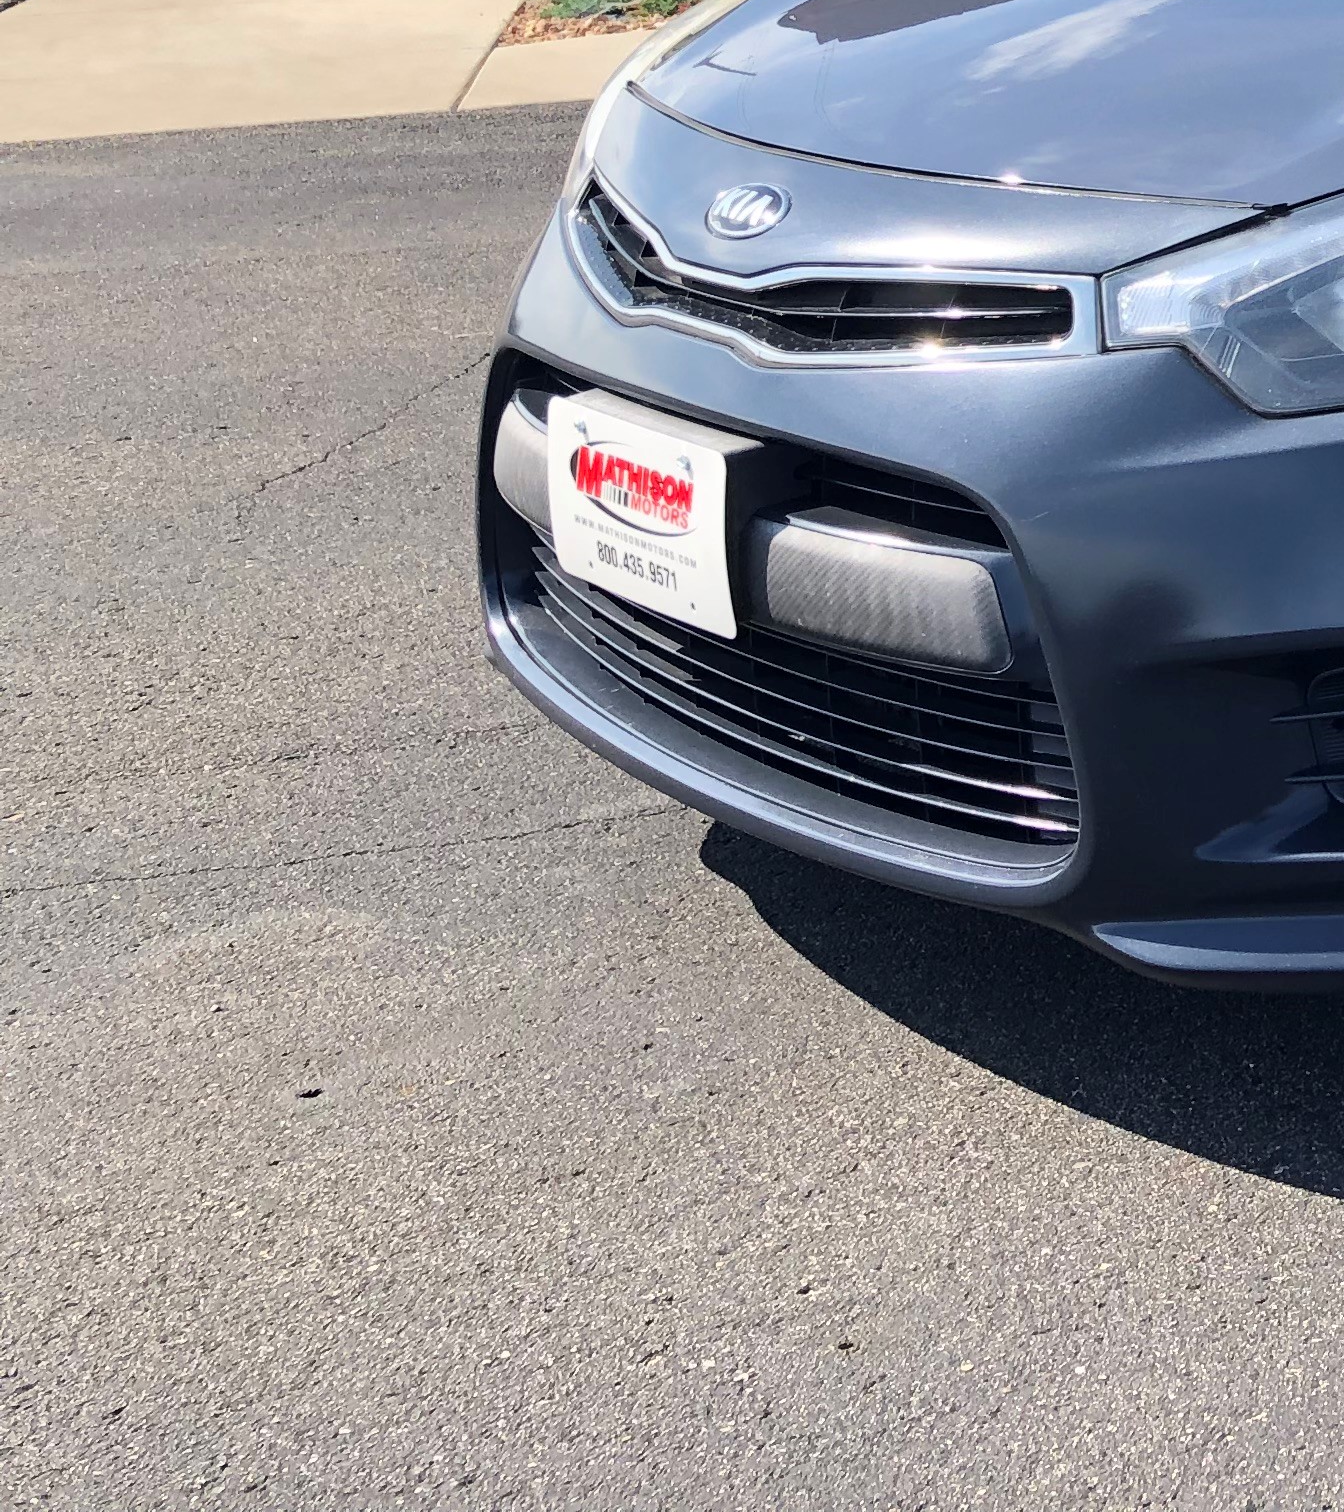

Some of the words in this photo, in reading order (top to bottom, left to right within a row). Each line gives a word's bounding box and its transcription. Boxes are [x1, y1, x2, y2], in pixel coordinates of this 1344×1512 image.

[577, 445, 694, 513] MATHISON
[631, 494, 689, 529] MOTORS
[597, 541, 678, 592] 800.435.9571
